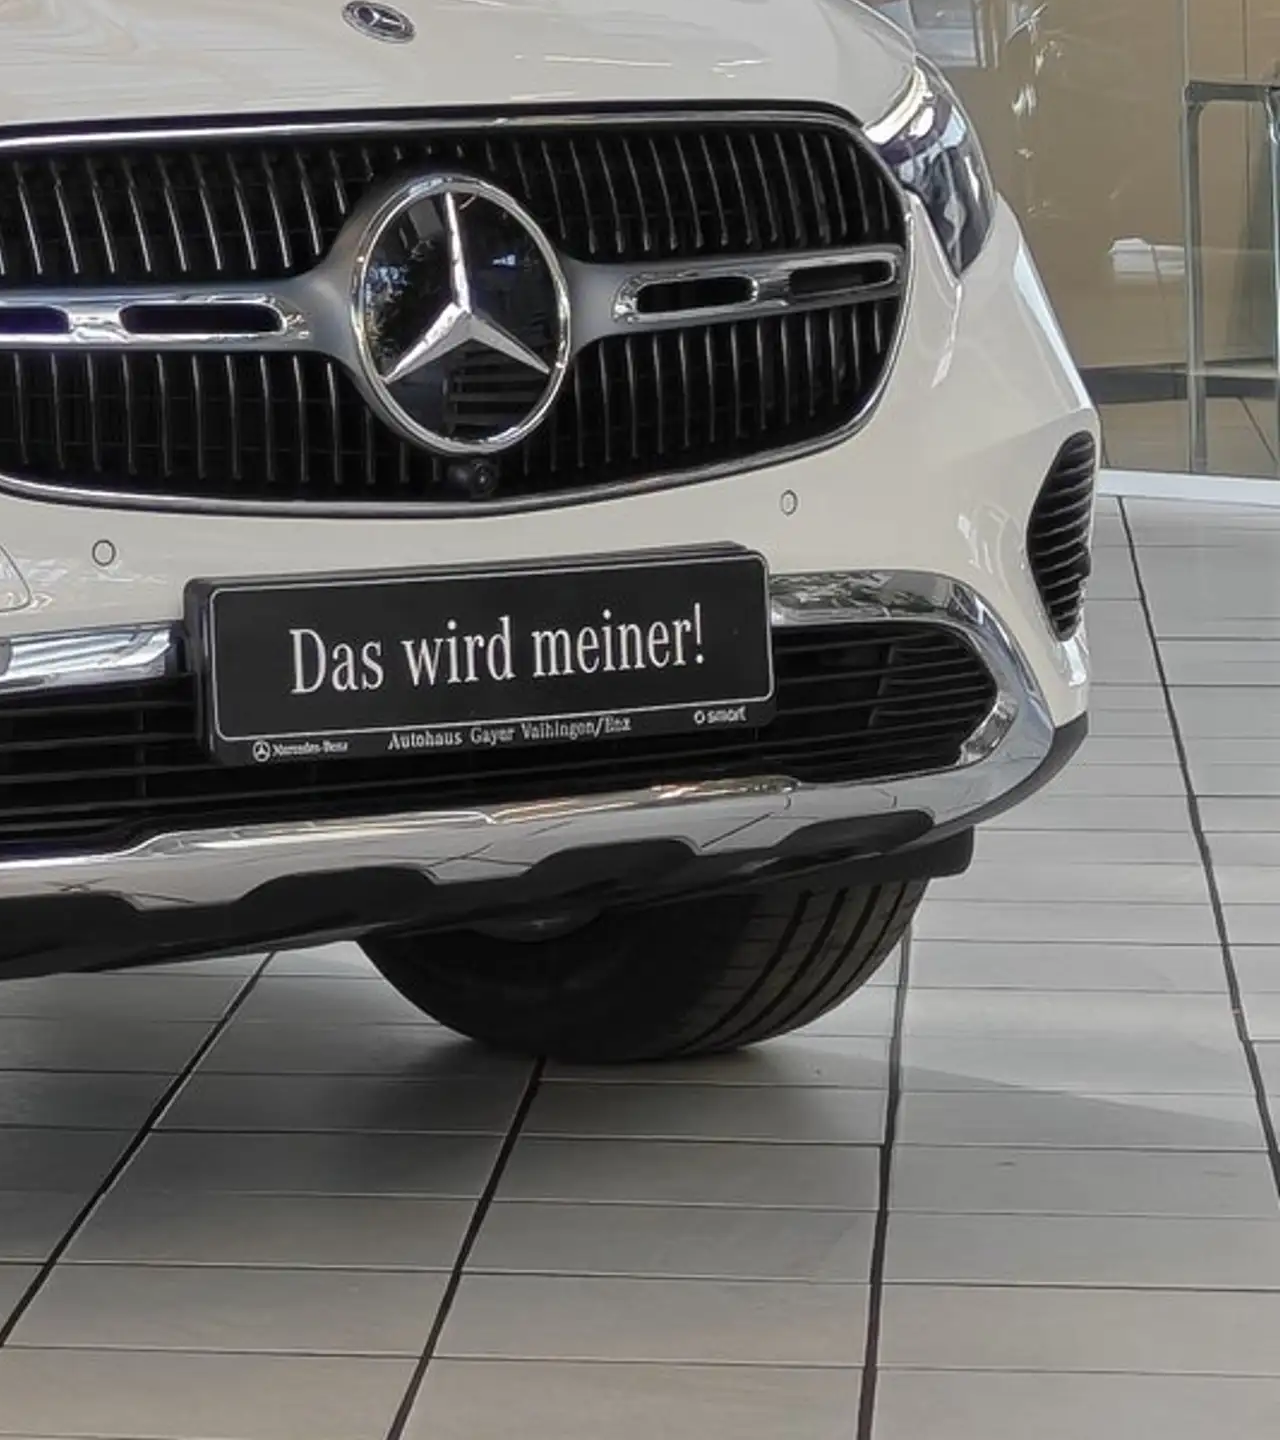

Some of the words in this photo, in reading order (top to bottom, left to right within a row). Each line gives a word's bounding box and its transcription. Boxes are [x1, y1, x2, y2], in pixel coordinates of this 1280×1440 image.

[288, 626, 385, 695] Das
[401, 614, 516, 687] wird
[530, 601, 705, 678] meiner!
[387, 729, 463, 751] Autohaus
[470, 726, 516, 747] Gayer
